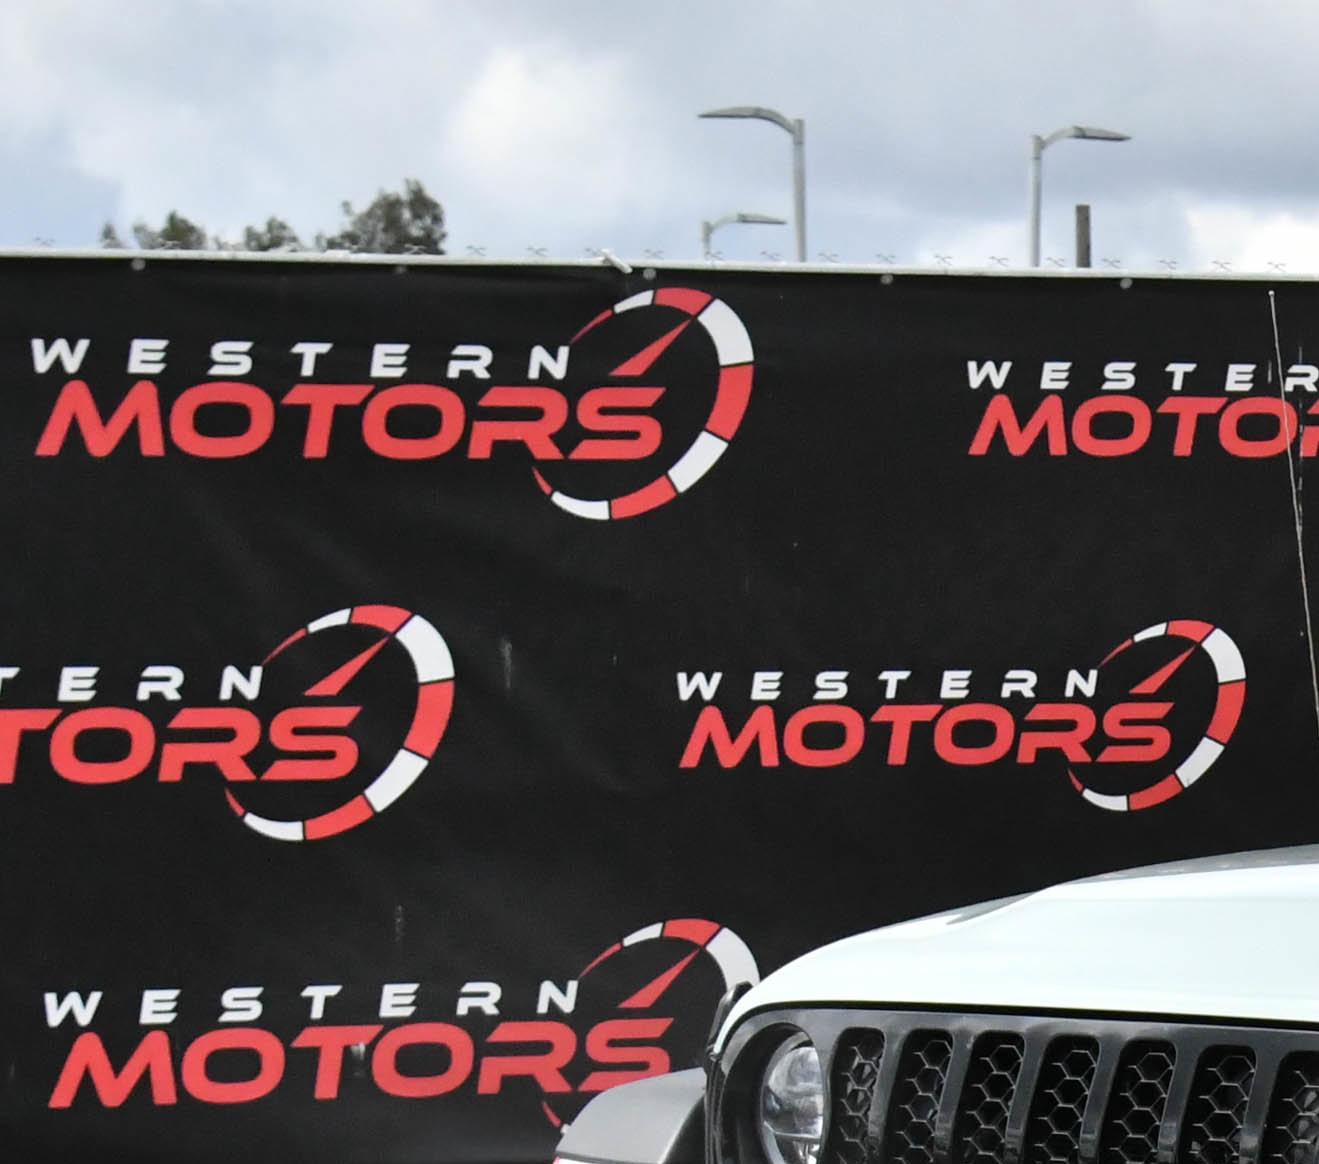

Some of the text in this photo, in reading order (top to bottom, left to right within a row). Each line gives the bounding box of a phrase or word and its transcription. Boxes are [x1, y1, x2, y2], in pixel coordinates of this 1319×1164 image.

[31, 338, 570, 378] WESTERN
[35, 379, 665, 460] MOTORS
[676, 669, 1098, 700] WESTERN
[679, 701, 1174, 769] MOTORS
[44, 980, 579, 1027] WESTERN
[47, 1017, 674, 1109] MOTORS
